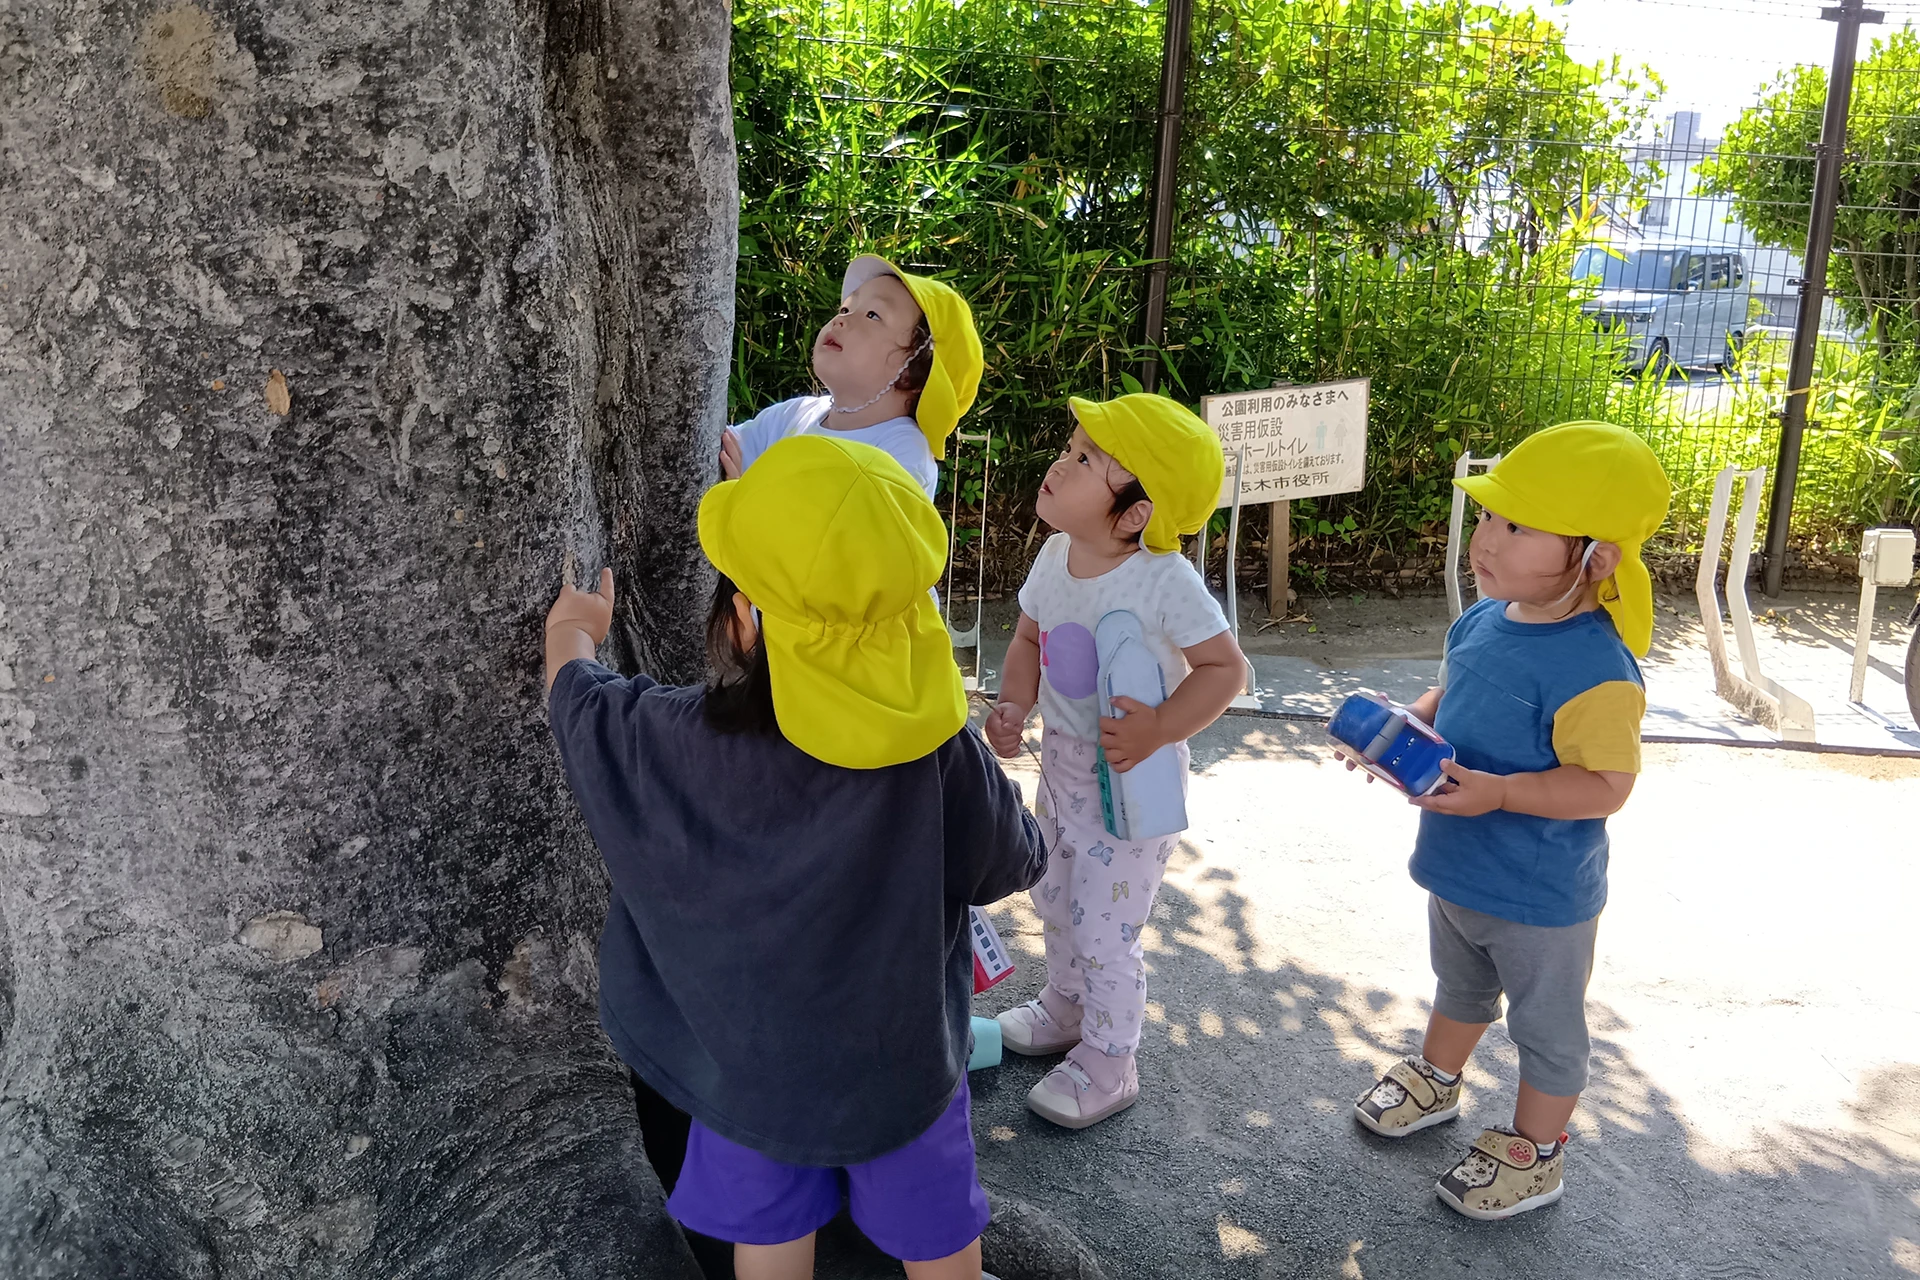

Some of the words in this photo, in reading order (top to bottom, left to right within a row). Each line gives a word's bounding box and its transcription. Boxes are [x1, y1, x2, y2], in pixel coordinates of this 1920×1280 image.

[1221, 390, 1349, 417] 公園利用のみなさまへ
[1218, 417, 1283, 442] 災害用仮設
